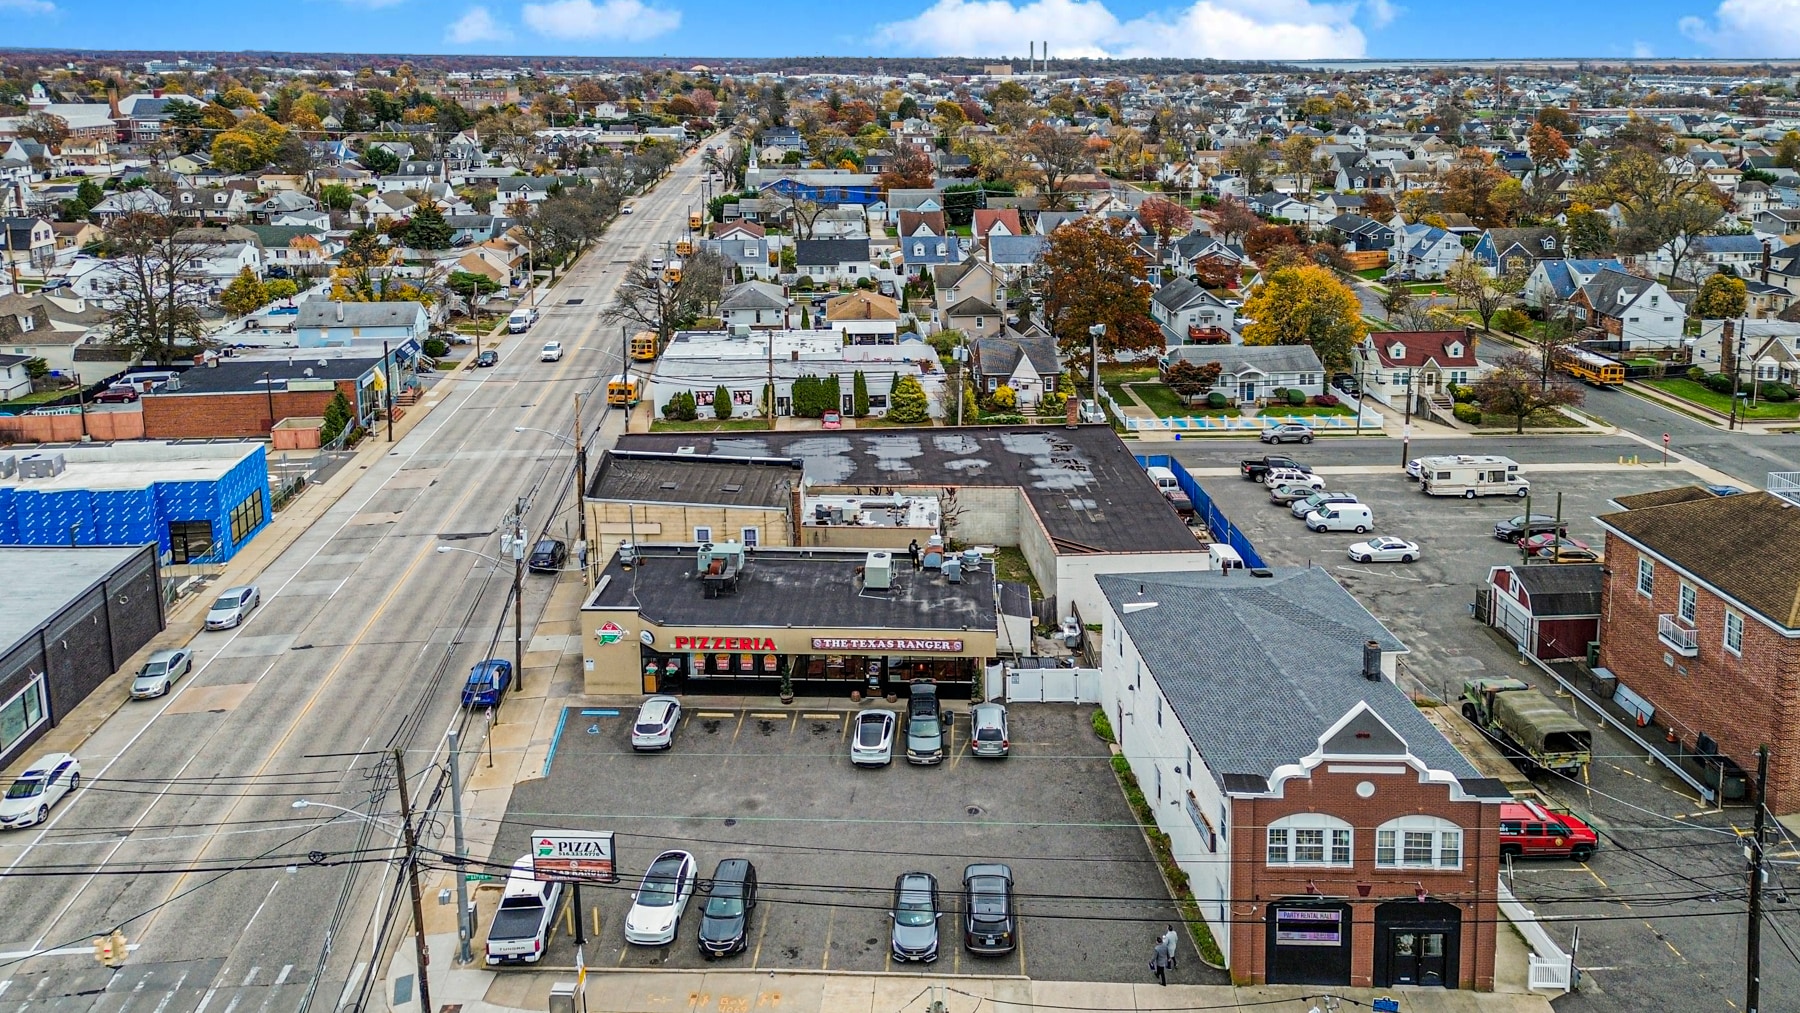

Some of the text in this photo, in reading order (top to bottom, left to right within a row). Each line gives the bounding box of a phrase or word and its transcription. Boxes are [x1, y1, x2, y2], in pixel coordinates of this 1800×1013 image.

[675, 636, 777, 650] PIZZERIA
[823, 639, 950, 650] THE TEXAS RANGER
[558, 842, 606, 855] PIZZA
